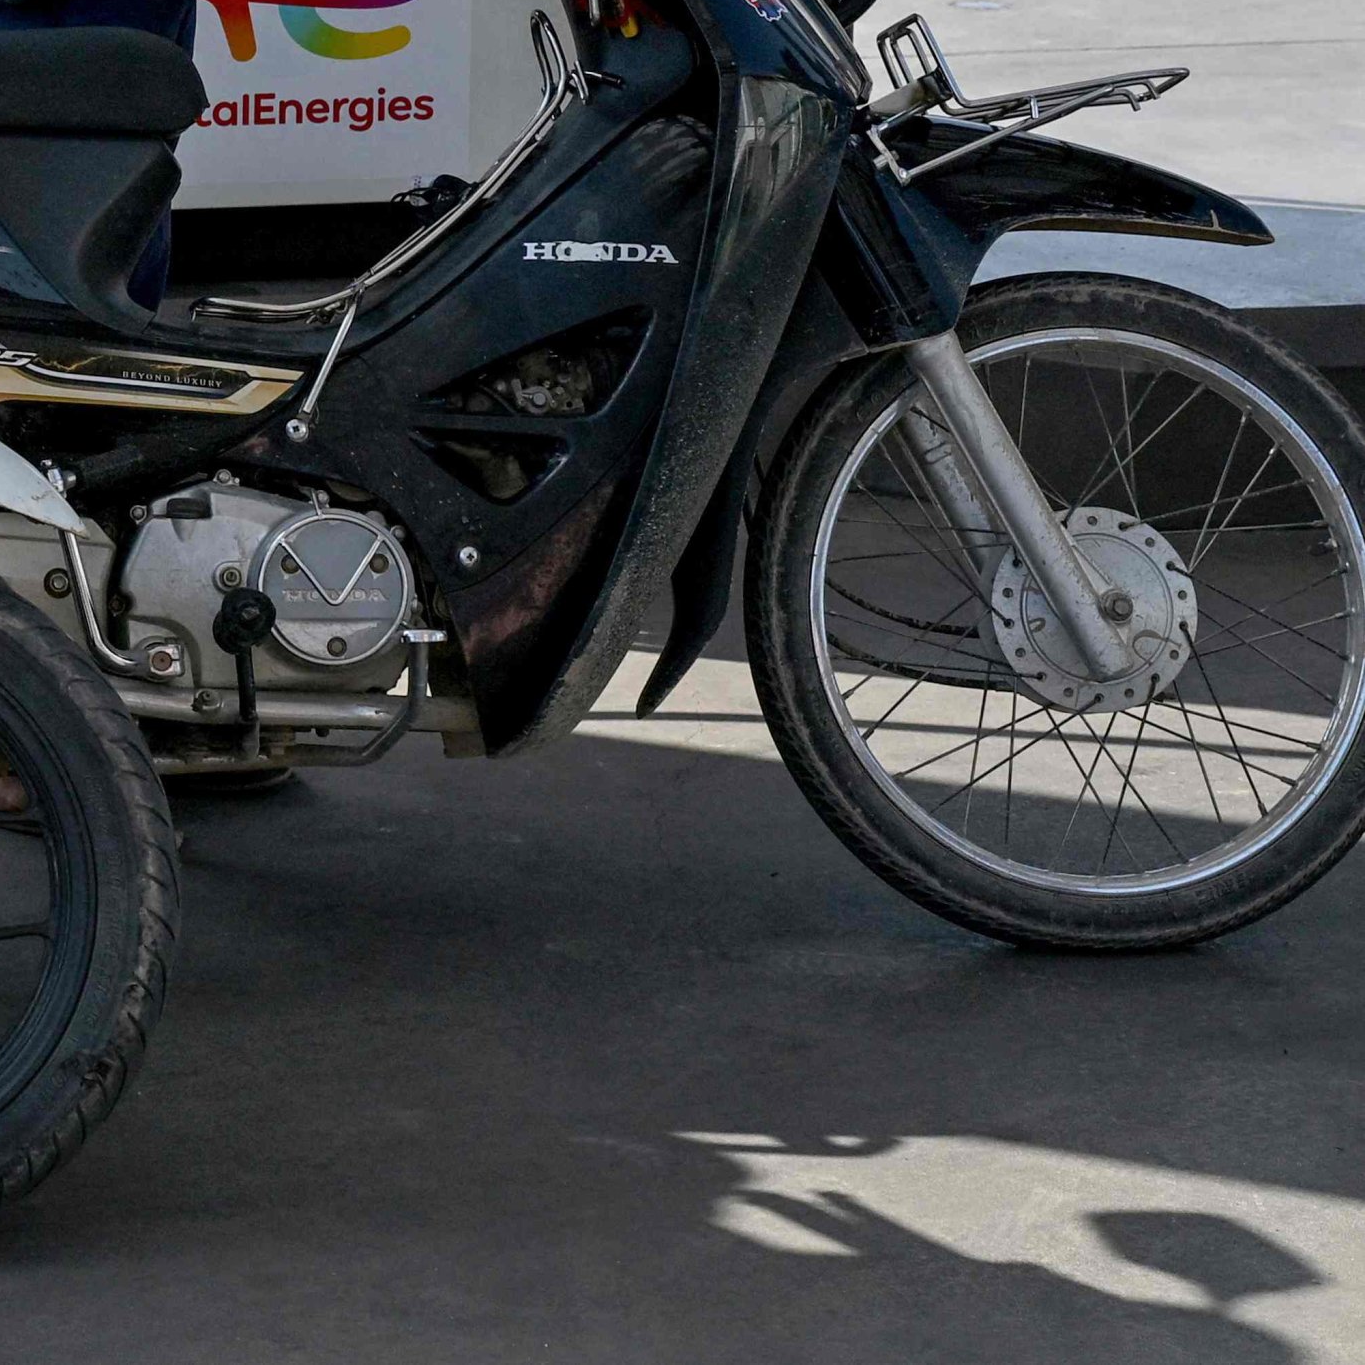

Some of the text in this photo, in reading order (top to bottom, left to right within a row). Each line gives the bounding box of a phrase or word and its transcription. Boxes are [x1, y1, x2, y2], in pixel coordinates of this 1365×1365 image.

[195, 87, 435, 132] alEnergies
[522, 240, 679, 265] HONDA
[122, 370, 223, 389] BEYOND LUXURY
